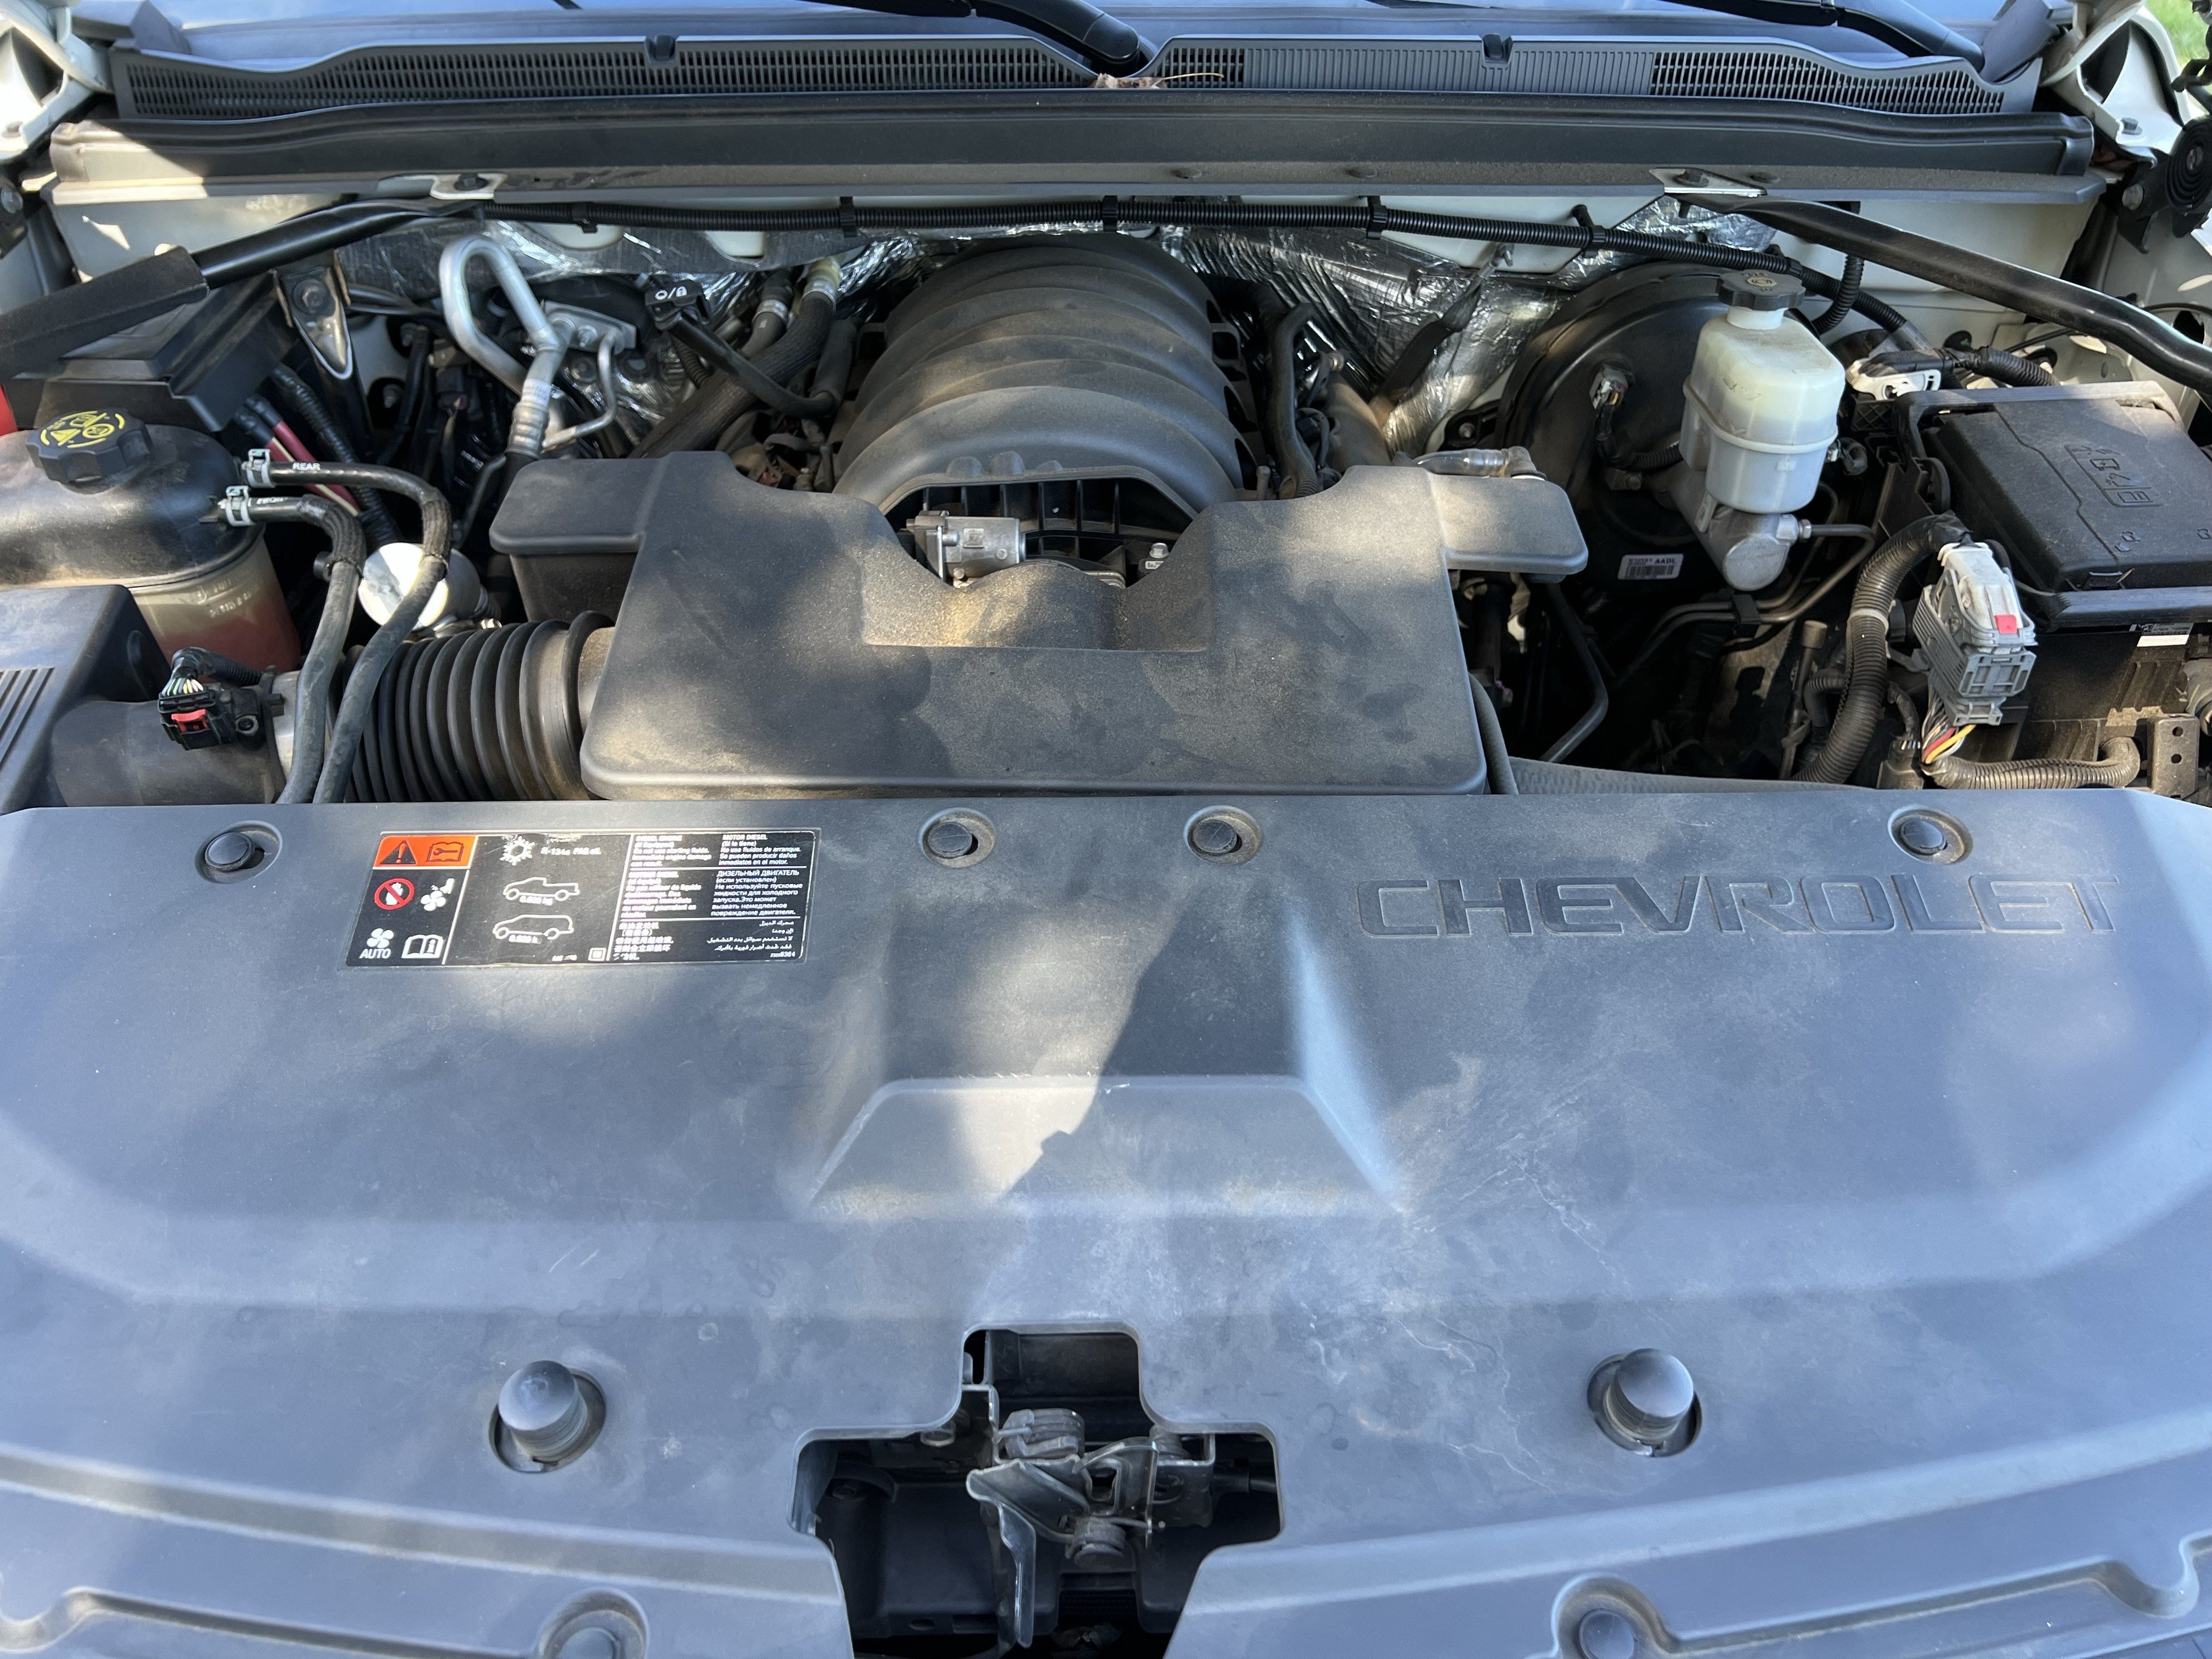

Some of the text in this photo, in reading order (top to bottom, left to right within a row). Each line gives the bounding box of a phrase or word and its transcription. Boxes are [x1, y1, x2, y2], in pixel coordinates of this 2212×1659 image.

[292, 462, 321, 471] REAR
[716, 869, 760, 877] ДИЗЕЛЬНЫЙ
[1357, 875, 2119, 938] CHEVROLET
[359, 948, 391, 959] AUTO
